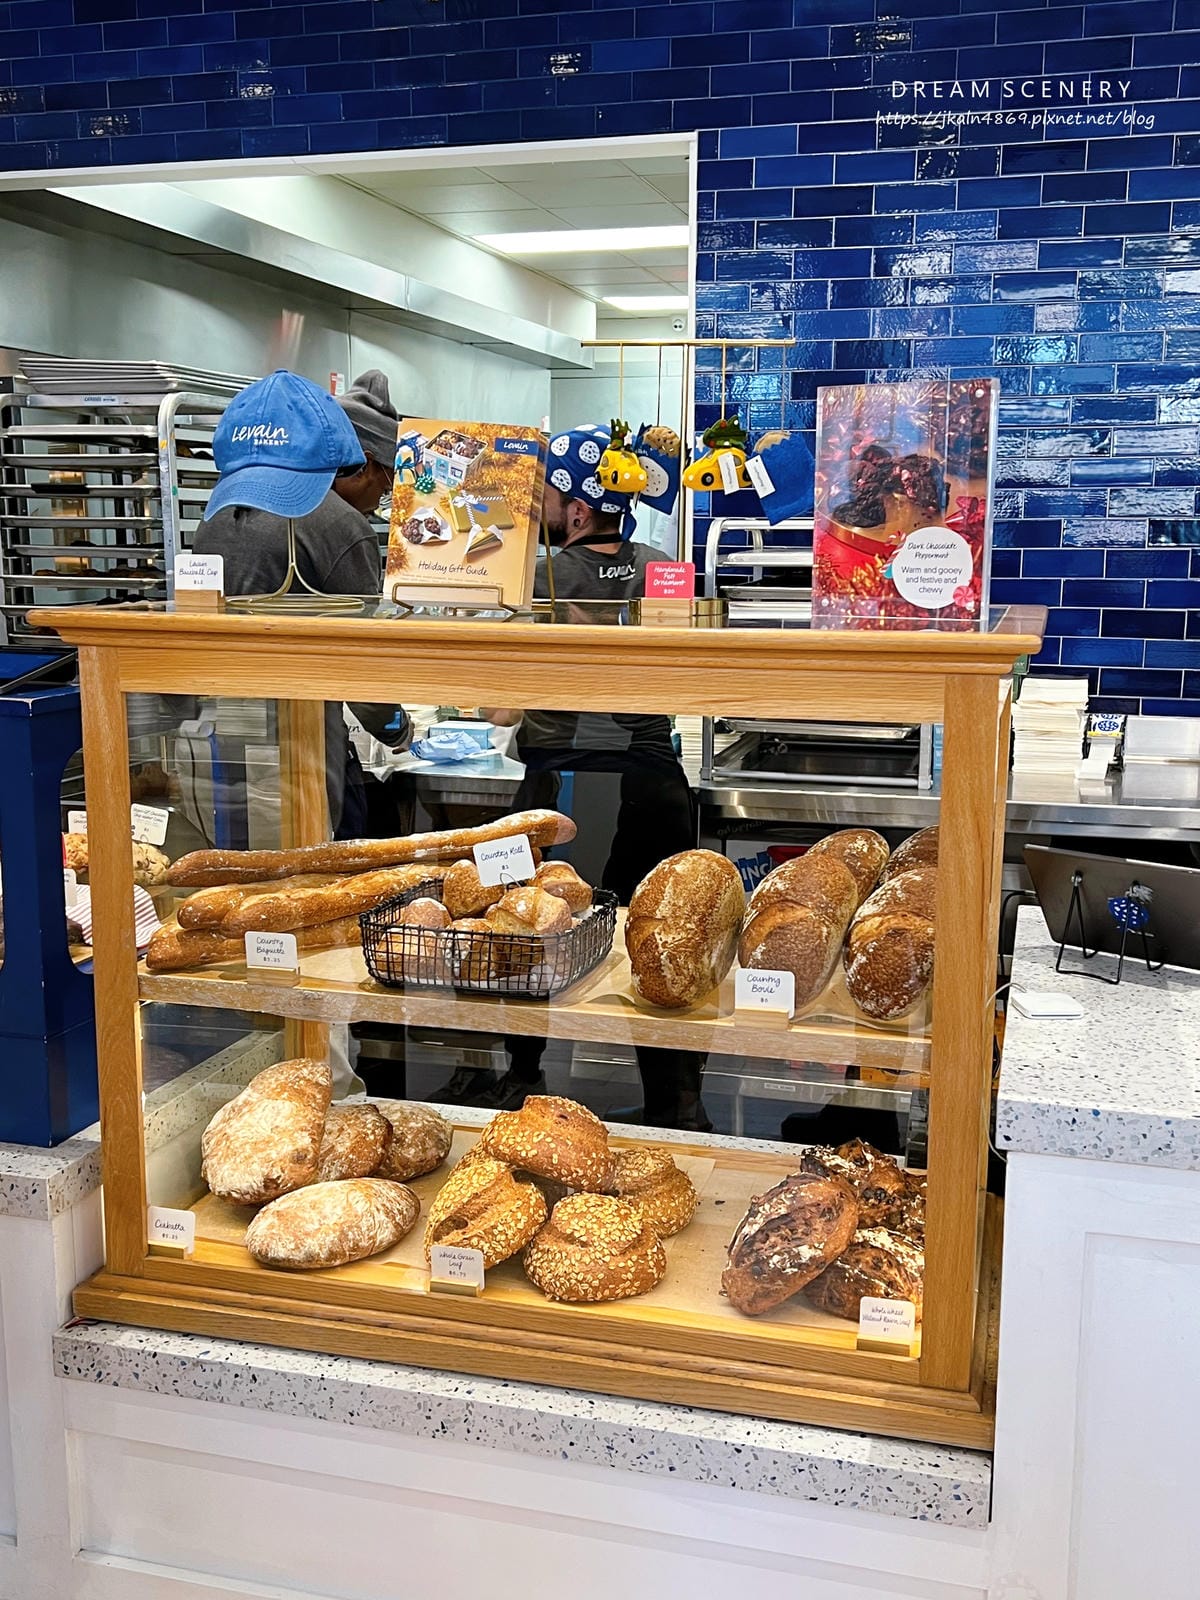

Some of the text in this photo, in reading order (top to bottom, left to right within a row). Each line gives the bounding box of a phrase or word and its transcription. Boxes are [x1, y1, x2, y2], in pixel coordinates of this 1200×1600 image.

[231, 421, 289, 443] Levain
[907, 542, 958, 550] Dark Chocolate
[418, 560, 489, 576] Holiday Gift Guide
[901, 566, 922, 574] Warm
[938, 567, 963, 576] gooey
[905, 576, 958, 584] and festive and
[918, 586, 944, 595] chewy
[480, 849, 509, 862] Country
[256, 936, 284, 948] Country
[746, 973, 781, 988] Country
